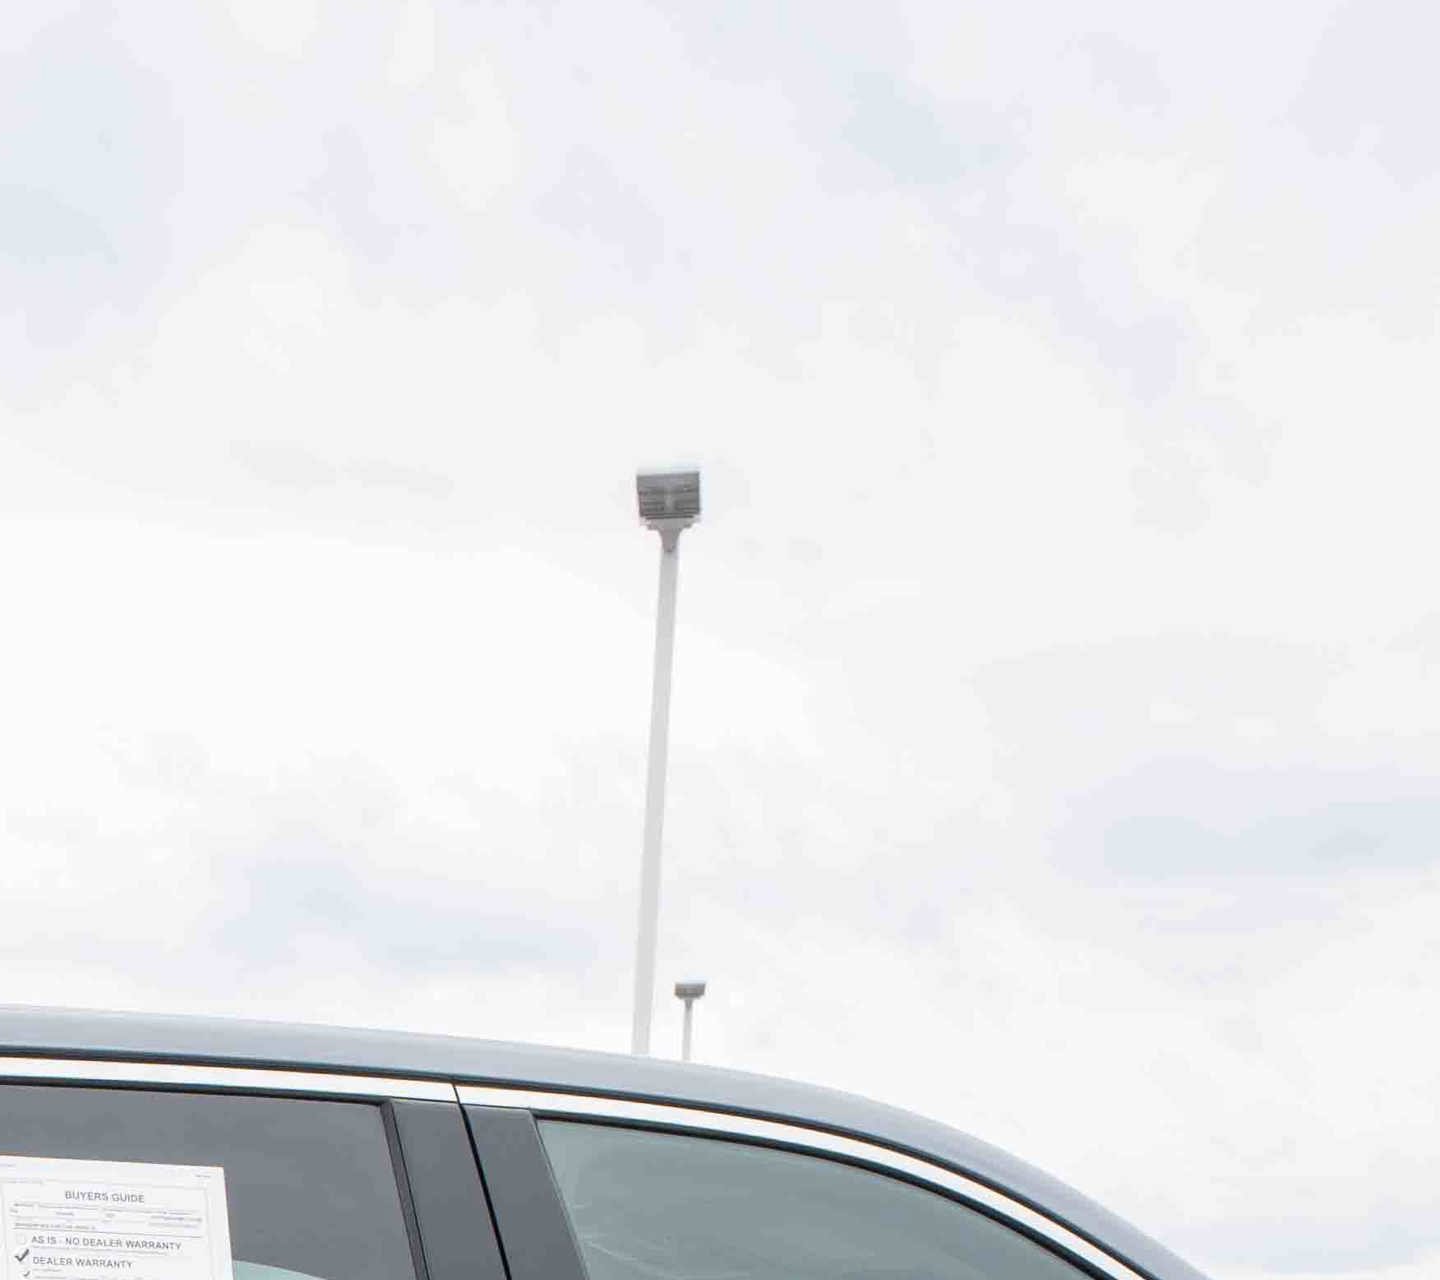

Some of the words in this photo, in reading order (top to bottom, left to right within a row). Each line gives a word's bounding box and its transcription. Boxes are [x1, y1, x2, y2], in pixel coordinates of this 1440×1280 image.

[65, 1191, 108, 1201] BUYERS
[112, 1193, 145, 1203] GUIDE
[31, 1236, 45, 1244] AS
[48, 1236, 57, 1244] IS
[65, 1237, 80, 1245] NO
[82, 1238, 122, 1248] DEALER
[125, 1240, 182, 1250] WARRANTY
[33, 1256, 73, 1267] DEALER
[75, 1258, 133, 1269] WARRANTY
